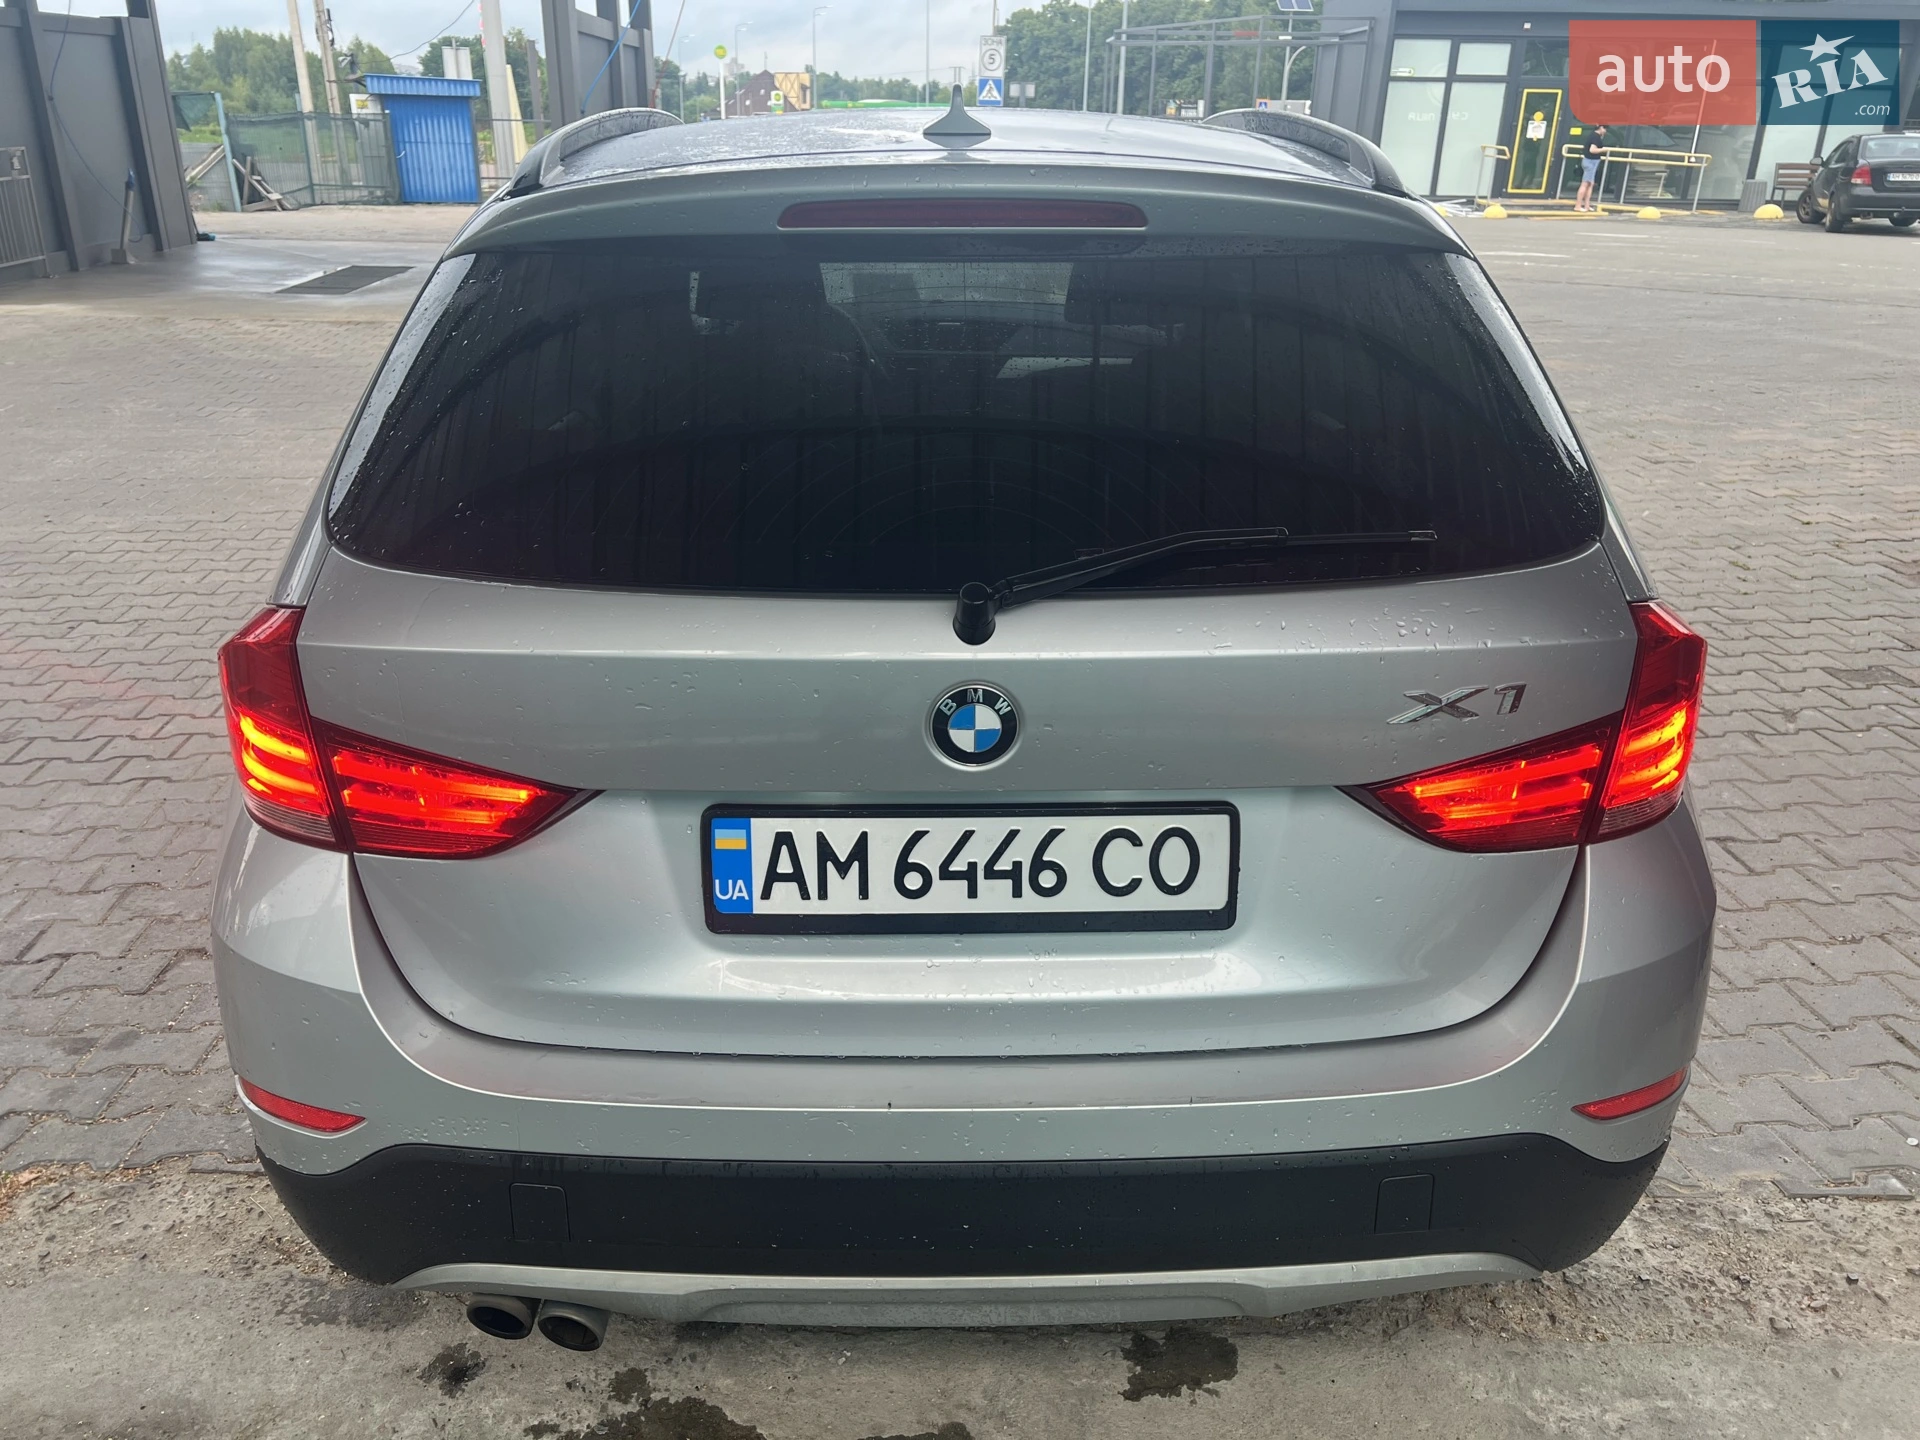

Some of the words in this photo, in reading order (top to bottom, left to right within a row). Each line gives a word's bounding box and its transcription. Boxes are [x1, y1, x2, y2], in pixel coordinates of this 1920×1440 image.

[987, 53, 996, 65] 5
[939, 688, 1012, 716] BMW
[1386, 681, 1528, 725] X1
[760, 830, 870, 901] AM
[893, 827, 1068, 899] 6446
[1092, 826, 1201, 897] CO
[714, 879, 750, 901] UA
